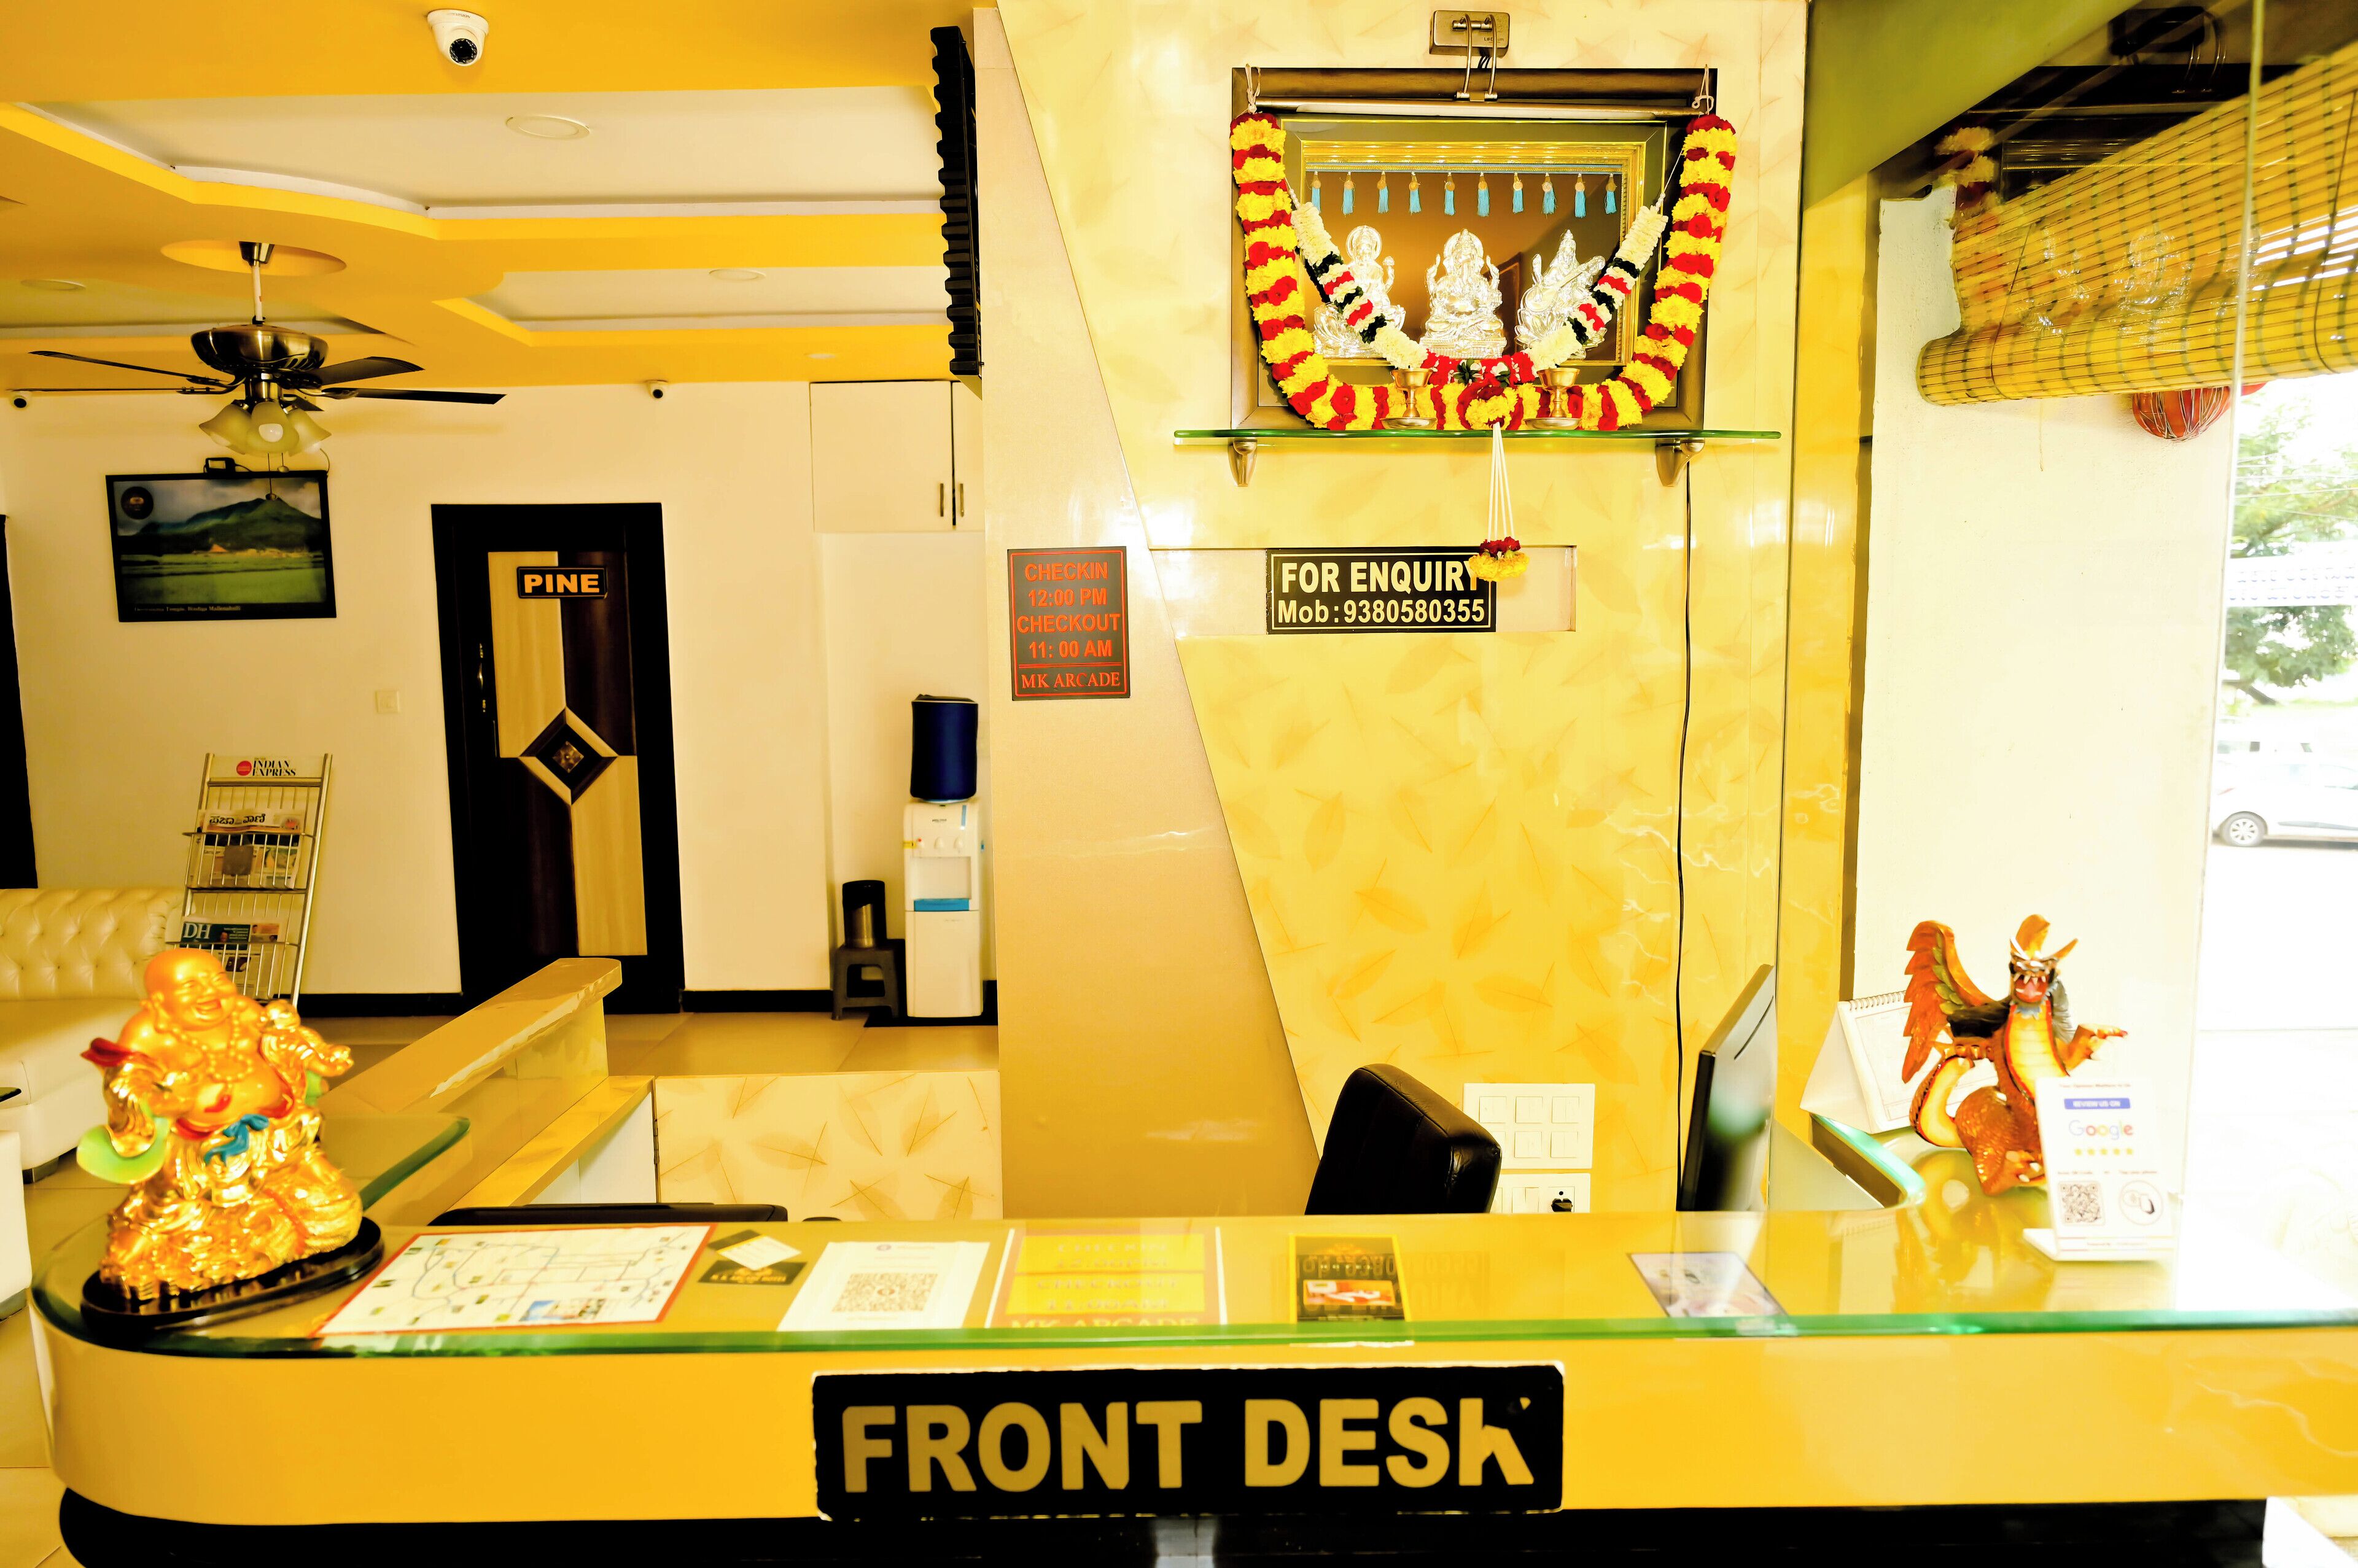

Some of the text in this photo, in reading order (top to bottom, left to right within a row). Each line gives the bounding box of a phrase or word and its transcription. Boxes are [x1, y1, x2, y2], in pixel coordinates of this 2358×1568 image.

[1025, 562, 1108, 581] CHECKIN
[1282, 562, 1340, 593] FOR
[524, 574, 599, 593] PINE
[1028, 588, 1107, 607] 12:00 PM
[1017, 613, 1121, 633] CHECKOUT
[1084, 639, 1112, 658] AM
[1021, 672, 1121, 689] MK ARCADE
[183, 923, 211, 939] DH
[2069, 1119, 2133, 1141] Google
[842, 1397, 1535, 1492] FRONT DESK
